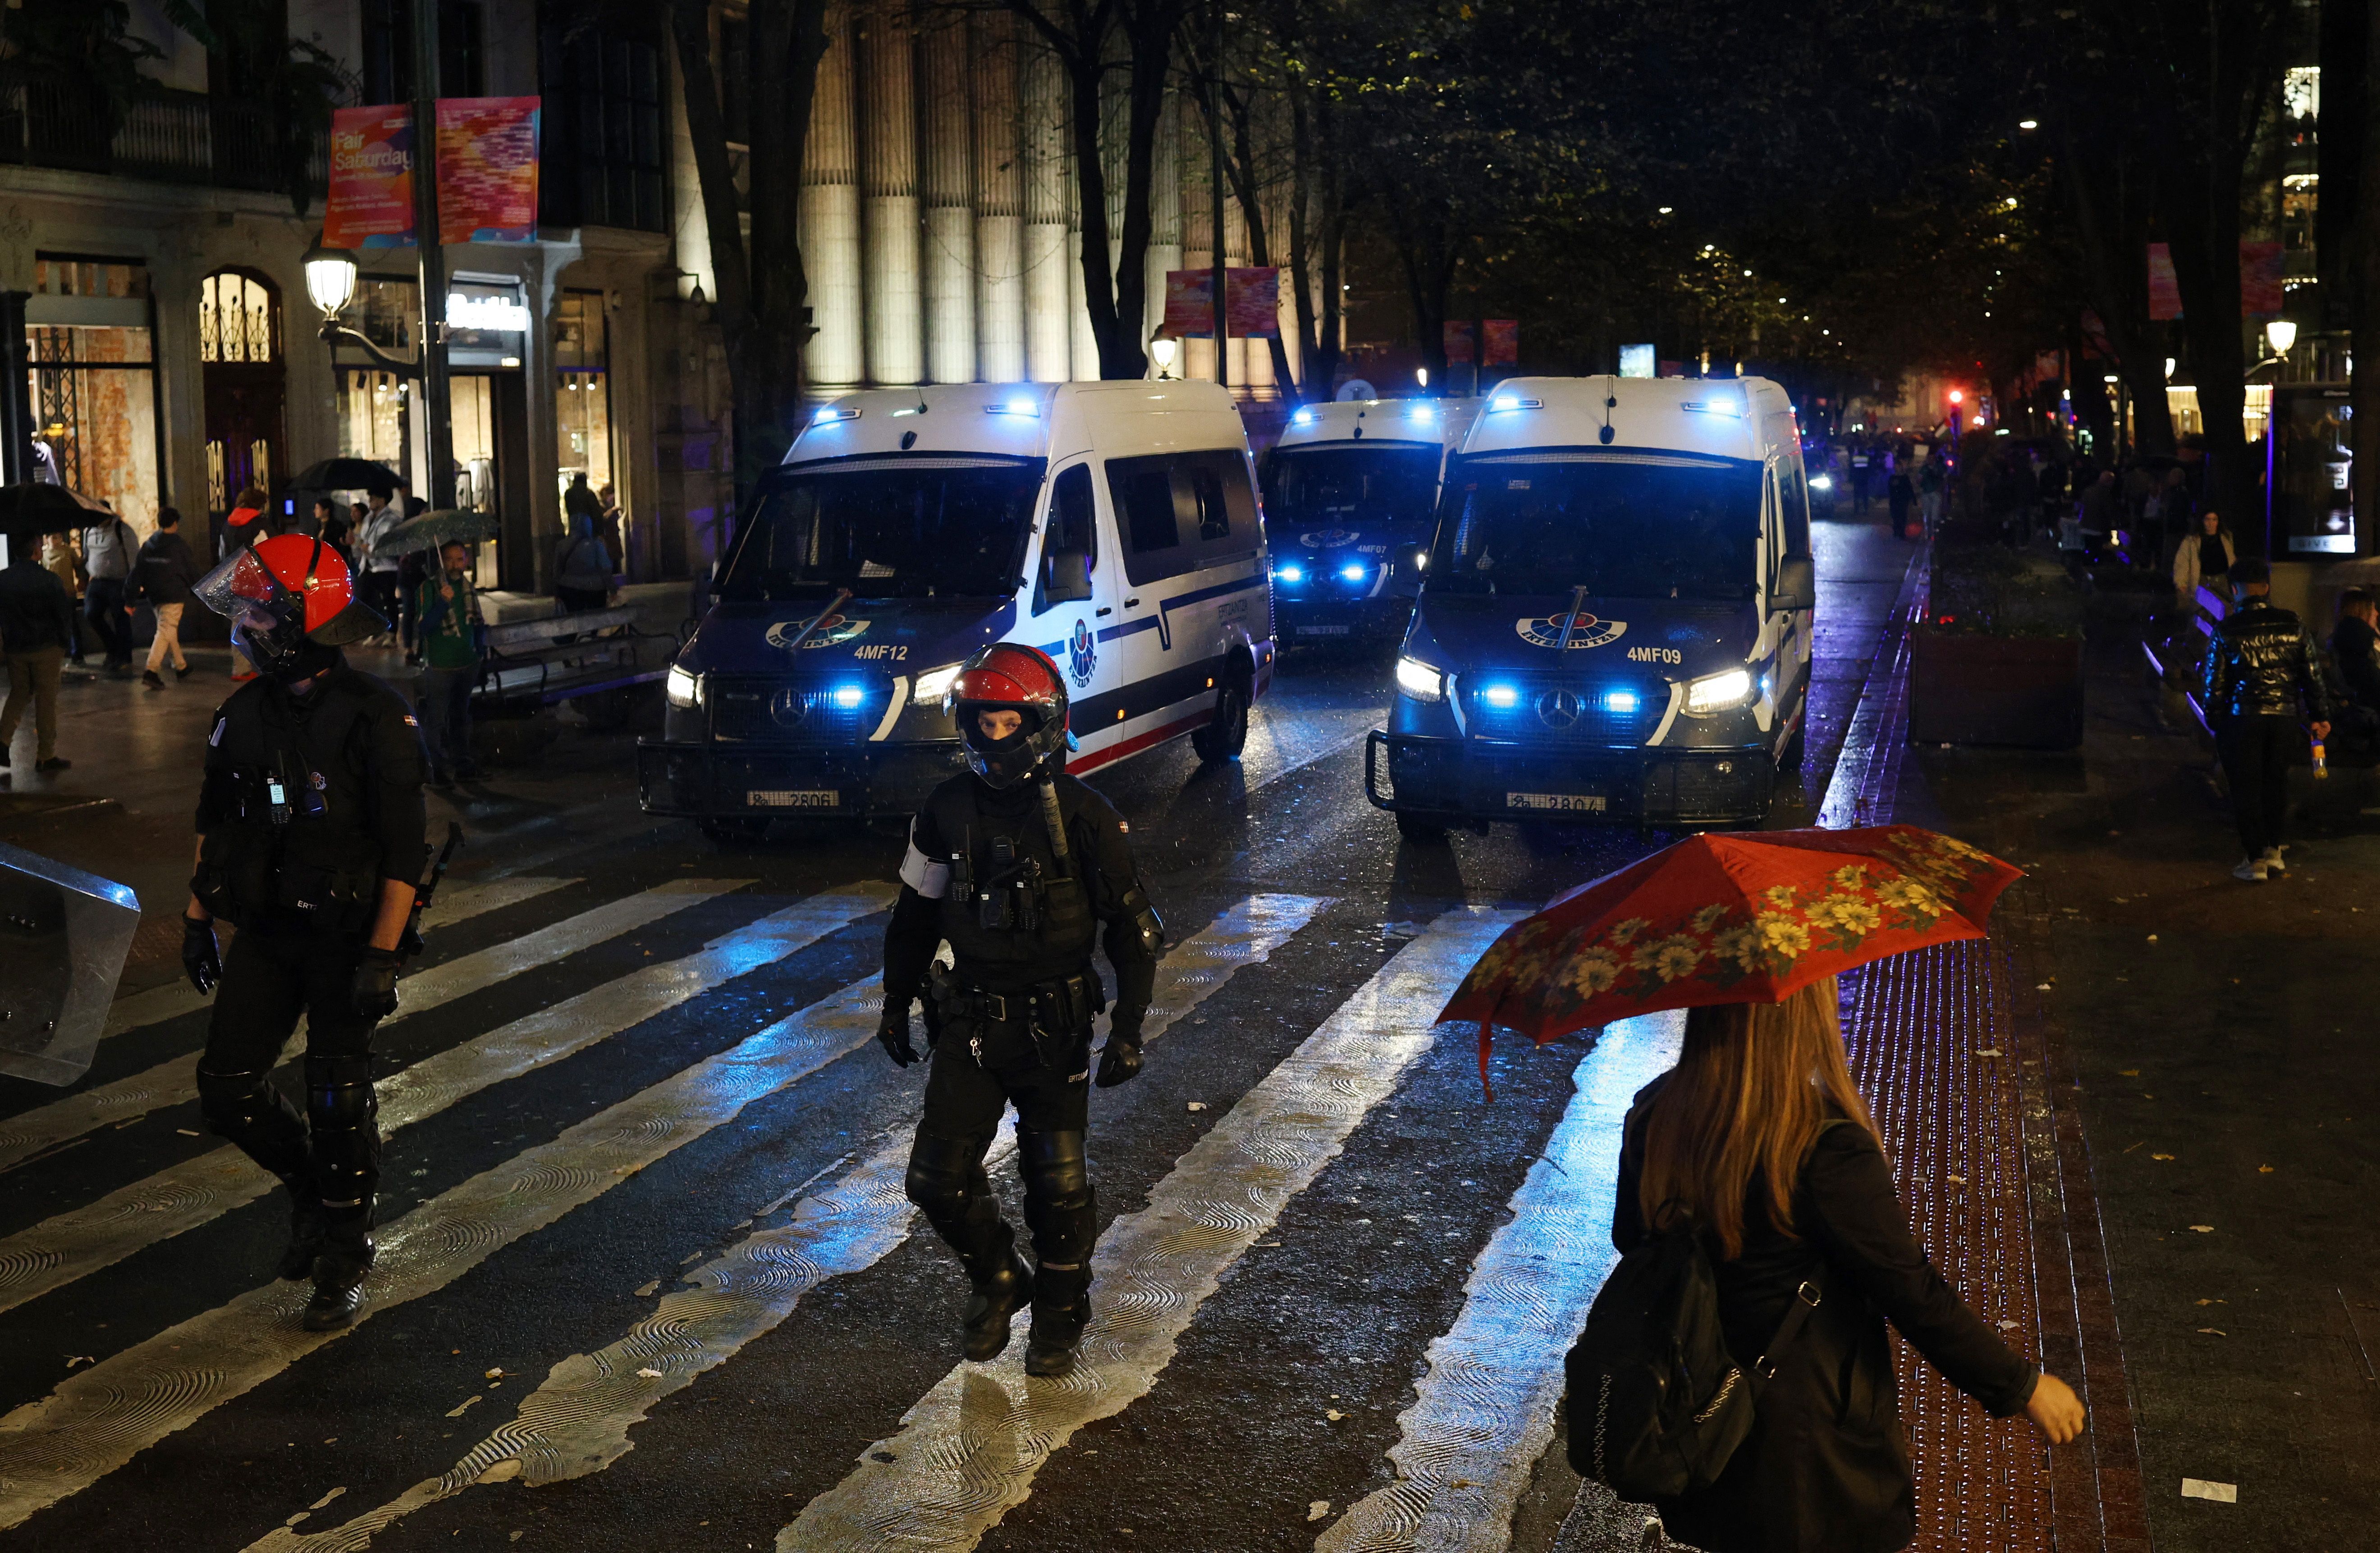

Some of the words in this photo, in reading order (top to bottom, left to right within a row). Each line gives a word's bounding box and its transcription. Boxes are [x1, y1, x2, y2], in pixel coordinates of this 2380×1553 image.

[334, 131, 366, 150] Fair
[335, 148, 414, 171] Saturday
[1357, 545, 1387, 553] 4MF07
[1521, 631, 1617, 647] ERTZINTZA
[854, 645, 908, 661] 4MF12
[1627, 647, 1681, 664] 4MF09
[1069, 655, 1097, 688] ERTZAINTZA
